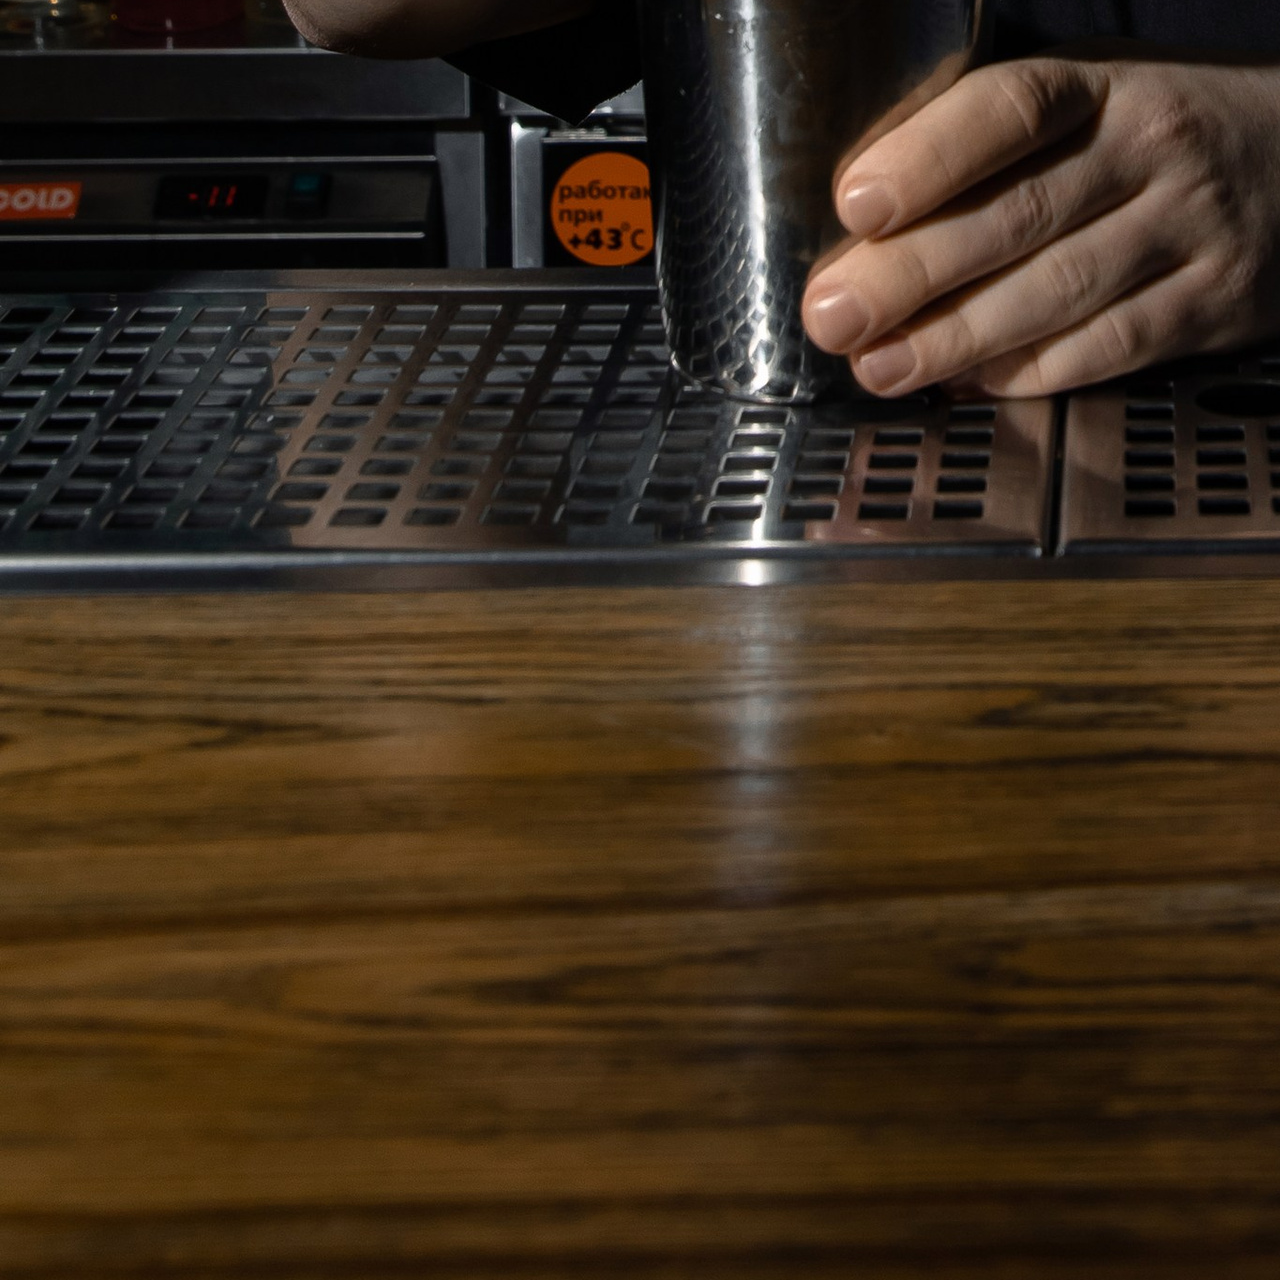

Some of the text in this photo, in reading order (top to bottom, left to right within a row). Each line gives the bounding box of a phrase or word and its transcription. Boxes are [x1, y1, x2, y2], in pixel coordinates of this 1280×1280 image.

[186, 185, 238, 208] -11
[559, 208, 604, 226] при
[567, 222, 646, 251] +43°C
